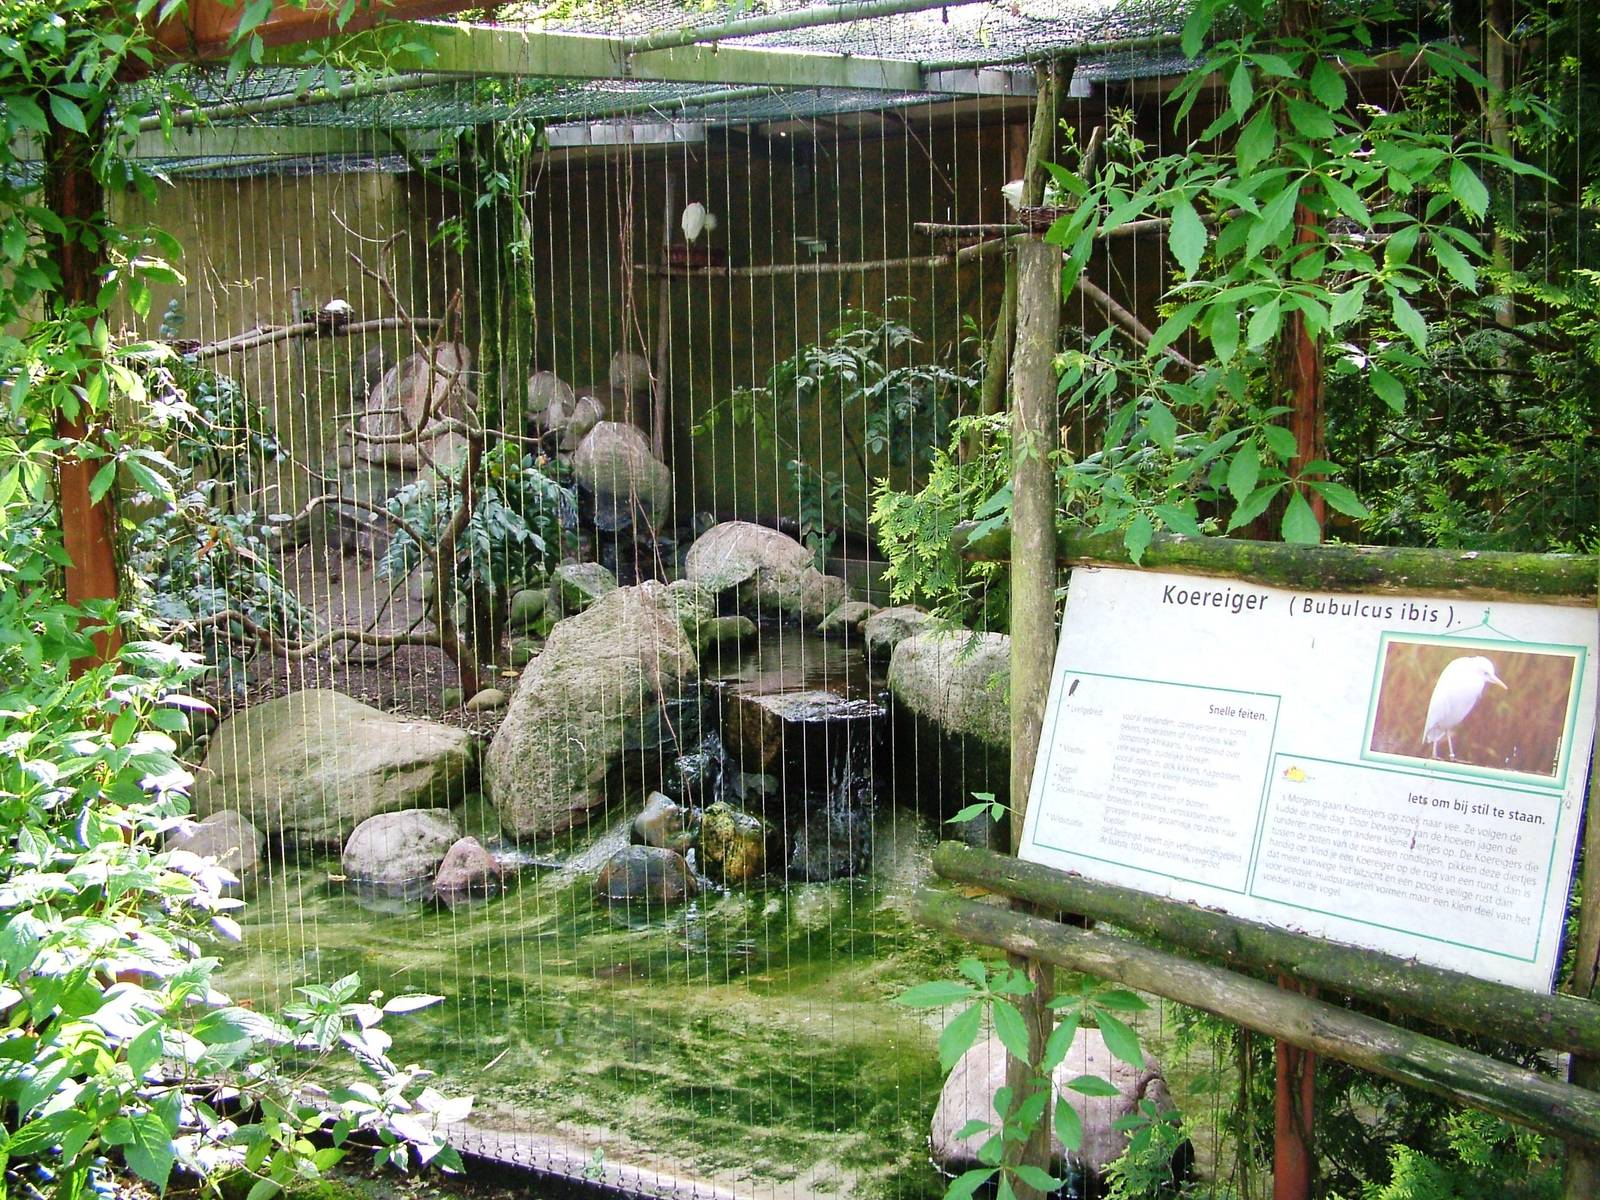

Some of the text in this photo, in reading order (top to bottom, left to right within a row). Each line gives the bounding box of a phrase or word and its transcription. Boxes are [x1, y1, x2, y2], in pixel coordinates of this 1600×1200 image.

[1162, 585, 1268, 614] Koereiger
[1208, 703, 1268, 721] Snelle feiten.
[1407, 792, 1545, 825] Iets om bij stil te staan.
[1370, 819, 1411, 837] beweging
[1430, 830, 1441, 841] de
[1443, 832, 1475, 847] hoeven
[1476, 838, 1503, 852] jagen
[1505, 843, 1518, 855] de
[1387, 812, 1399, 823] op
[1464, 823, 1475, 834] Ze
[1477, 827, 1508, 840] volgen
[1509, 831, 1522, 842] de
[1355, 854, 1393, 871] Koereiger
[1396, 864, 1408, 875] op
[1409, 864, 1421, 875] de
[1423, 870, 1438, 881] rug
[1440, 873, 1456, 883] van
[1457, 876, 1474, 886] een
[1503, 883, 1521, 896] dan
[1360, 845, 1397, 858] runderen
[1447, 860, 1477, 874] pikken
[1479, 865, 1501, 878] deze
[1502, 869, 1537, 886] diertjes
[1459, 848, 1472, 860] De
[1473, 851, 1522, 869] Koereigers
[1523, 860, 1539, 872] die
[1375, 885, 1407, 898] vormen
[1409, 892, 1430, 903] maar
[1432, 897, 1449, 908] een
[1451, 899, 1472, 912] klein
[1474, 904, 1494, 917] deel
[1495, 911, 1512, 921] van
[1513, 912, 1531, 925] het
[1444, 886, 1473, 901] veilige
[1475, 893, 1493, 904] rust
